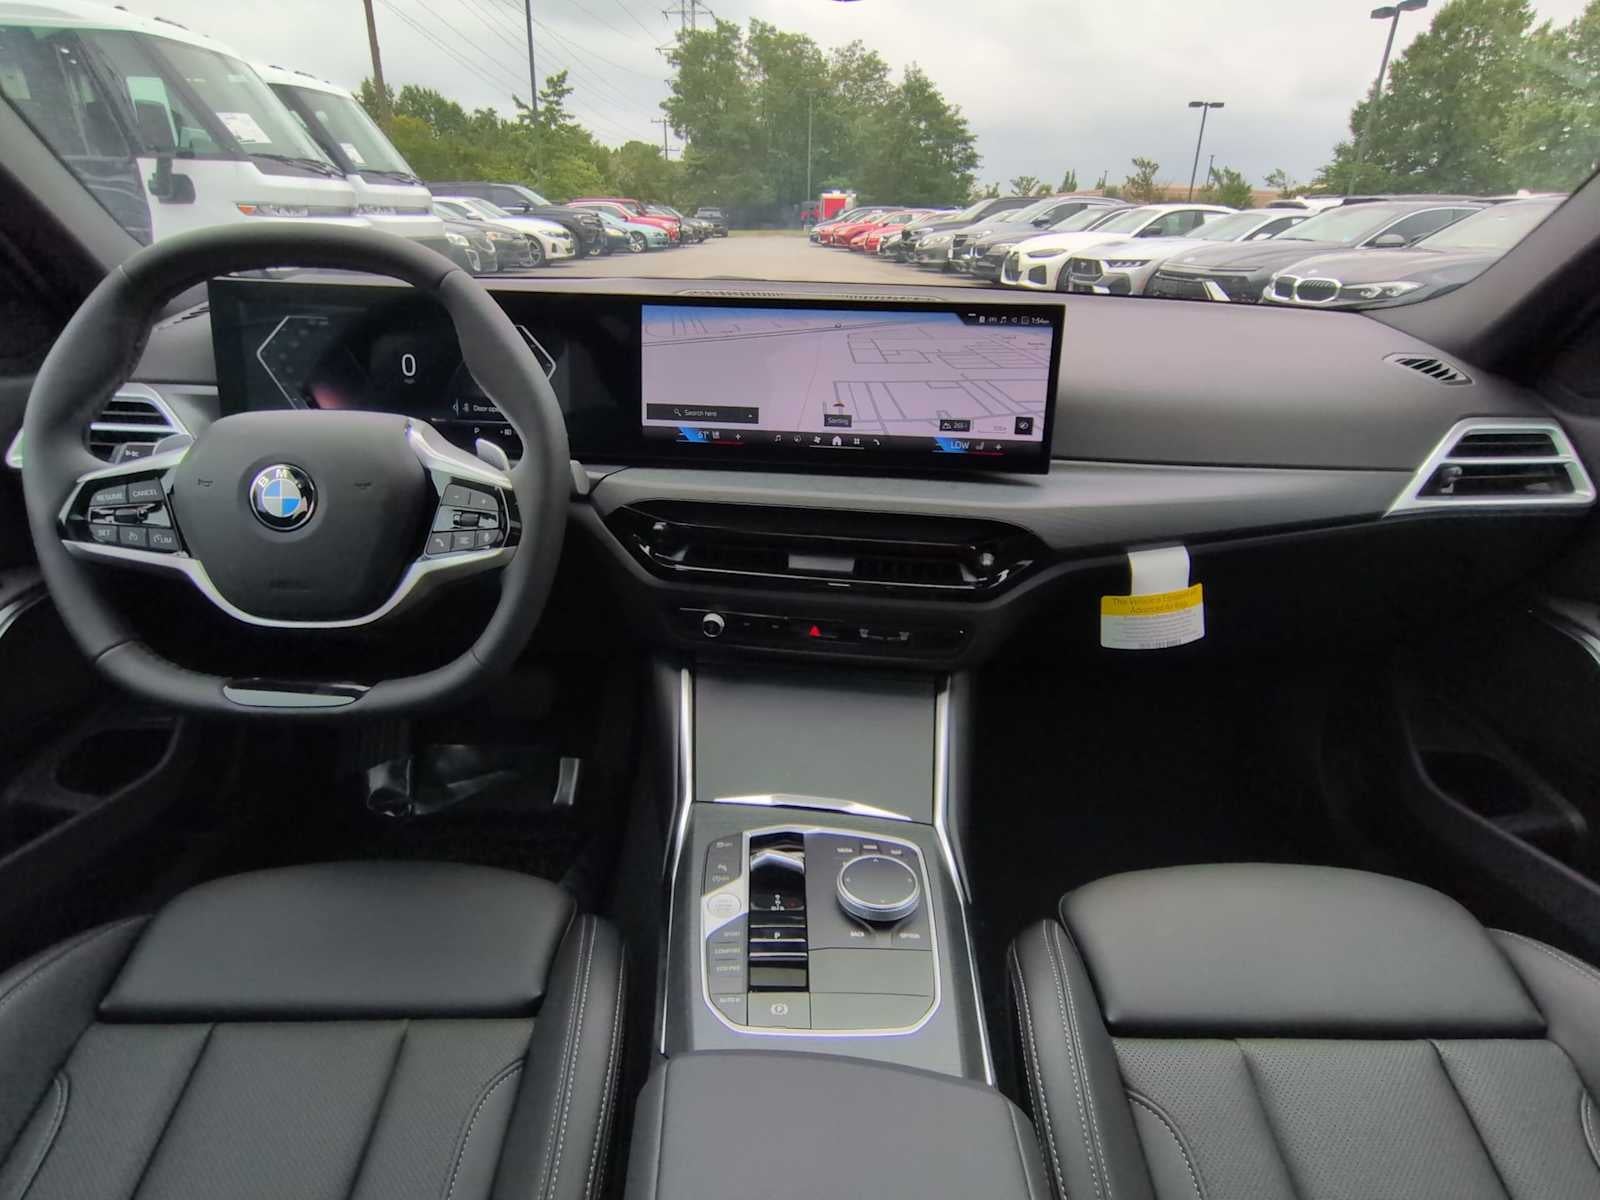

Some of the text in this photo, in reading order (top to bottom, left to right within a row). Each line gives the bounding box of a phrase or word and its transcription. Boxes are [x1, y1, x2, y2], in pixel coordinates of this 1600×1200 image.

[401, 353, 417, 377] 0
[473, 404, 487, 412] Door
[950, 440, 970, 449] LOW
[132, 489, 159, 497] CANCEL
